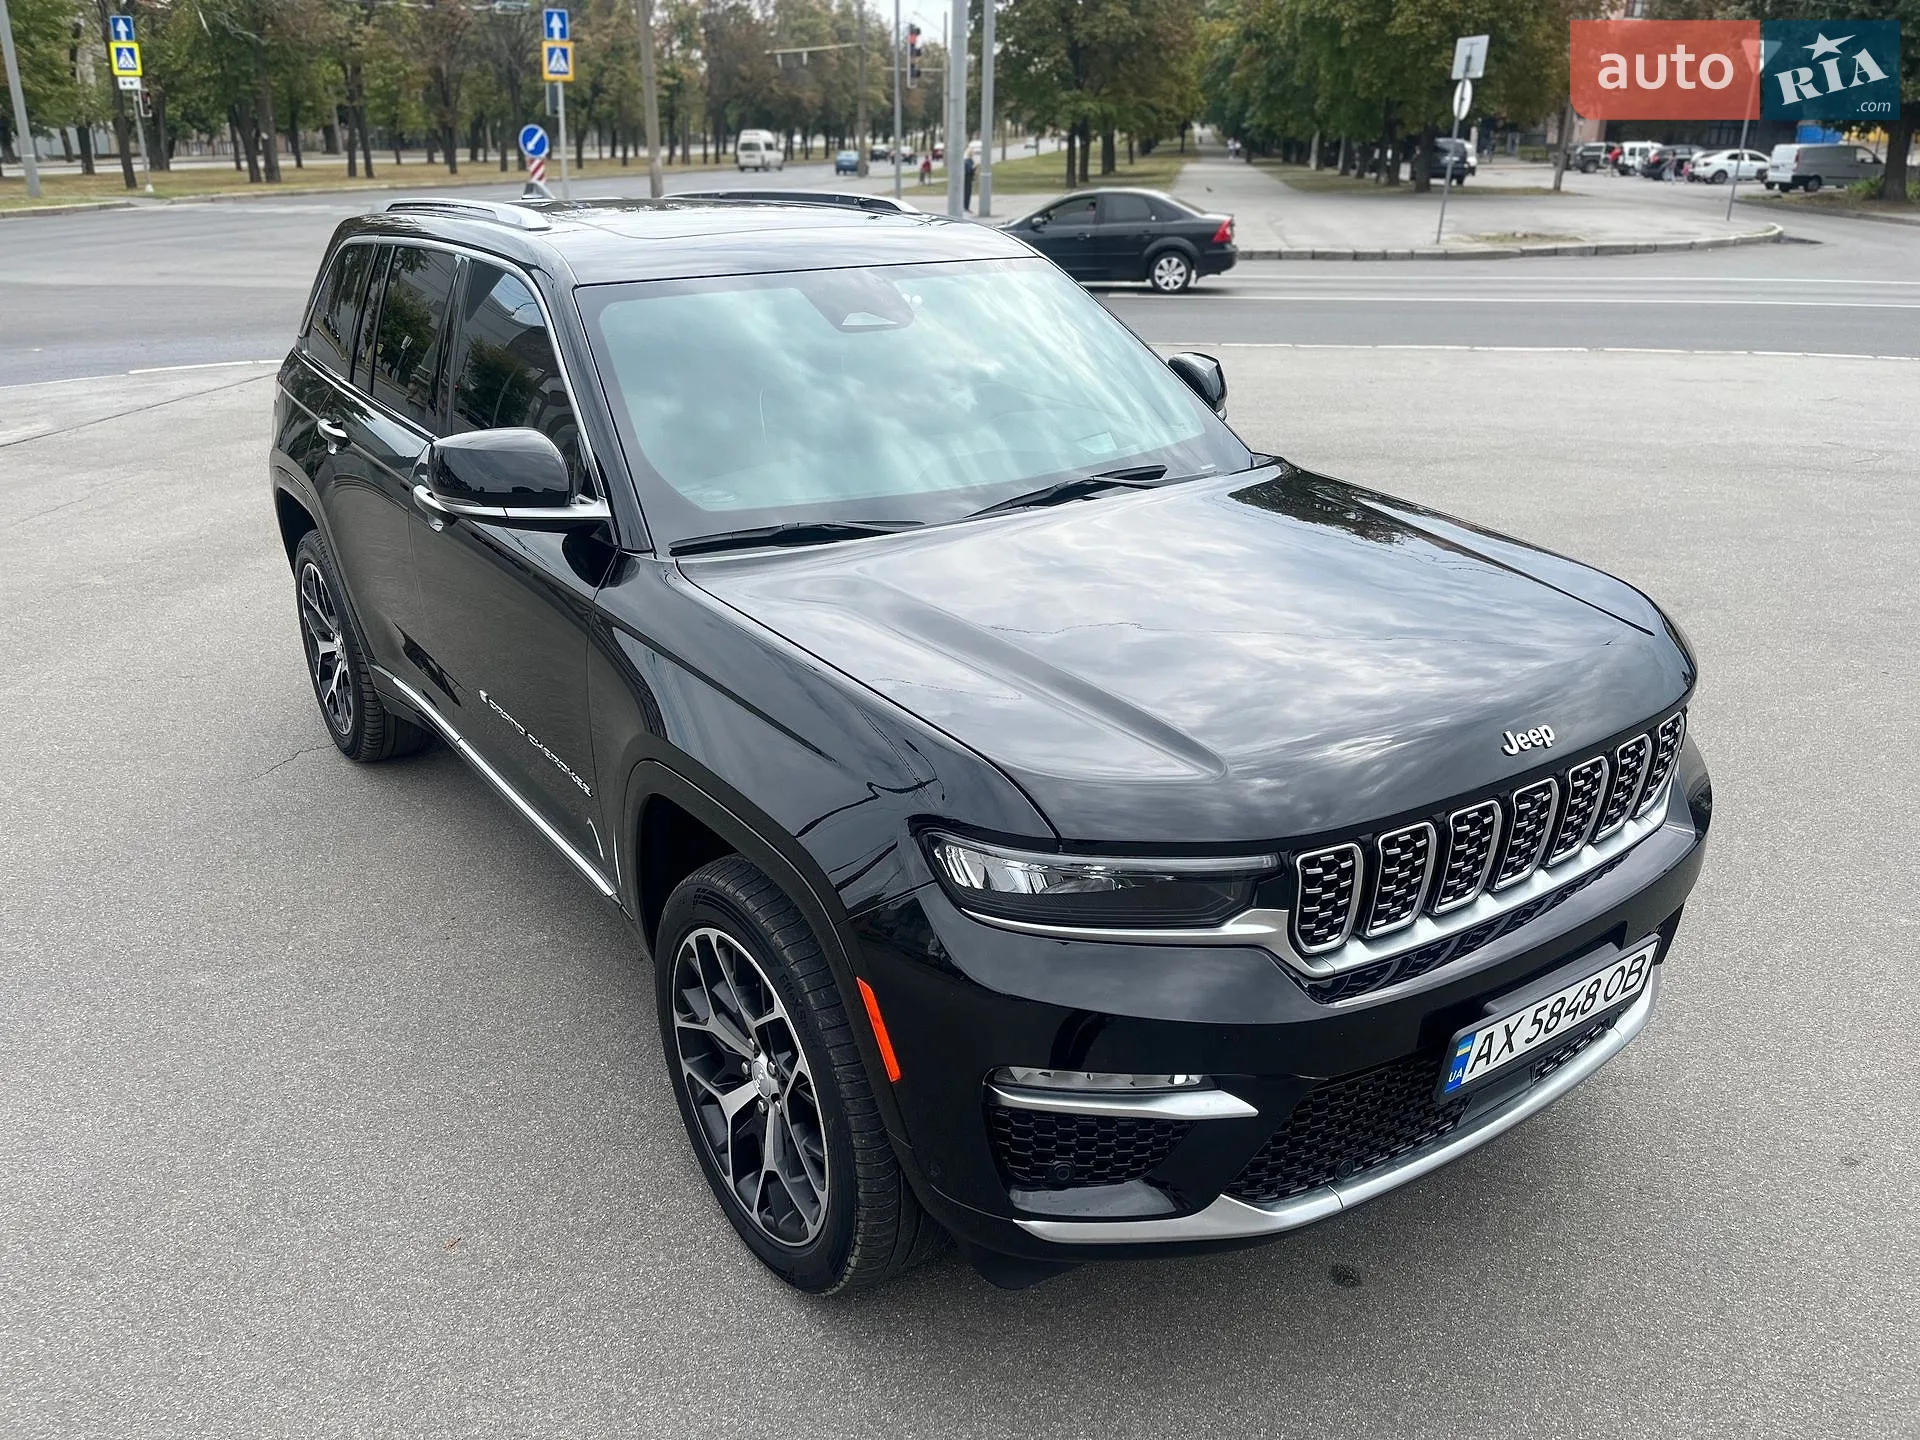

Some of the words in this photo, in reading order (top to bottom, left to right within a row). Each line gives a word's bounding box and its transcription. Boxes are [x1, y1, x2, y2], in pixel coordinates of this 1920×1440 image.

[1502, 724, 1556, 756] Jeep
[1468, 1015, 1525, 1074] AX
[1525, 978, 1602, 1044] 5848
[1603, 953, 1647, 1002] OB
[1449, 1069, 1463, 1083] UA
